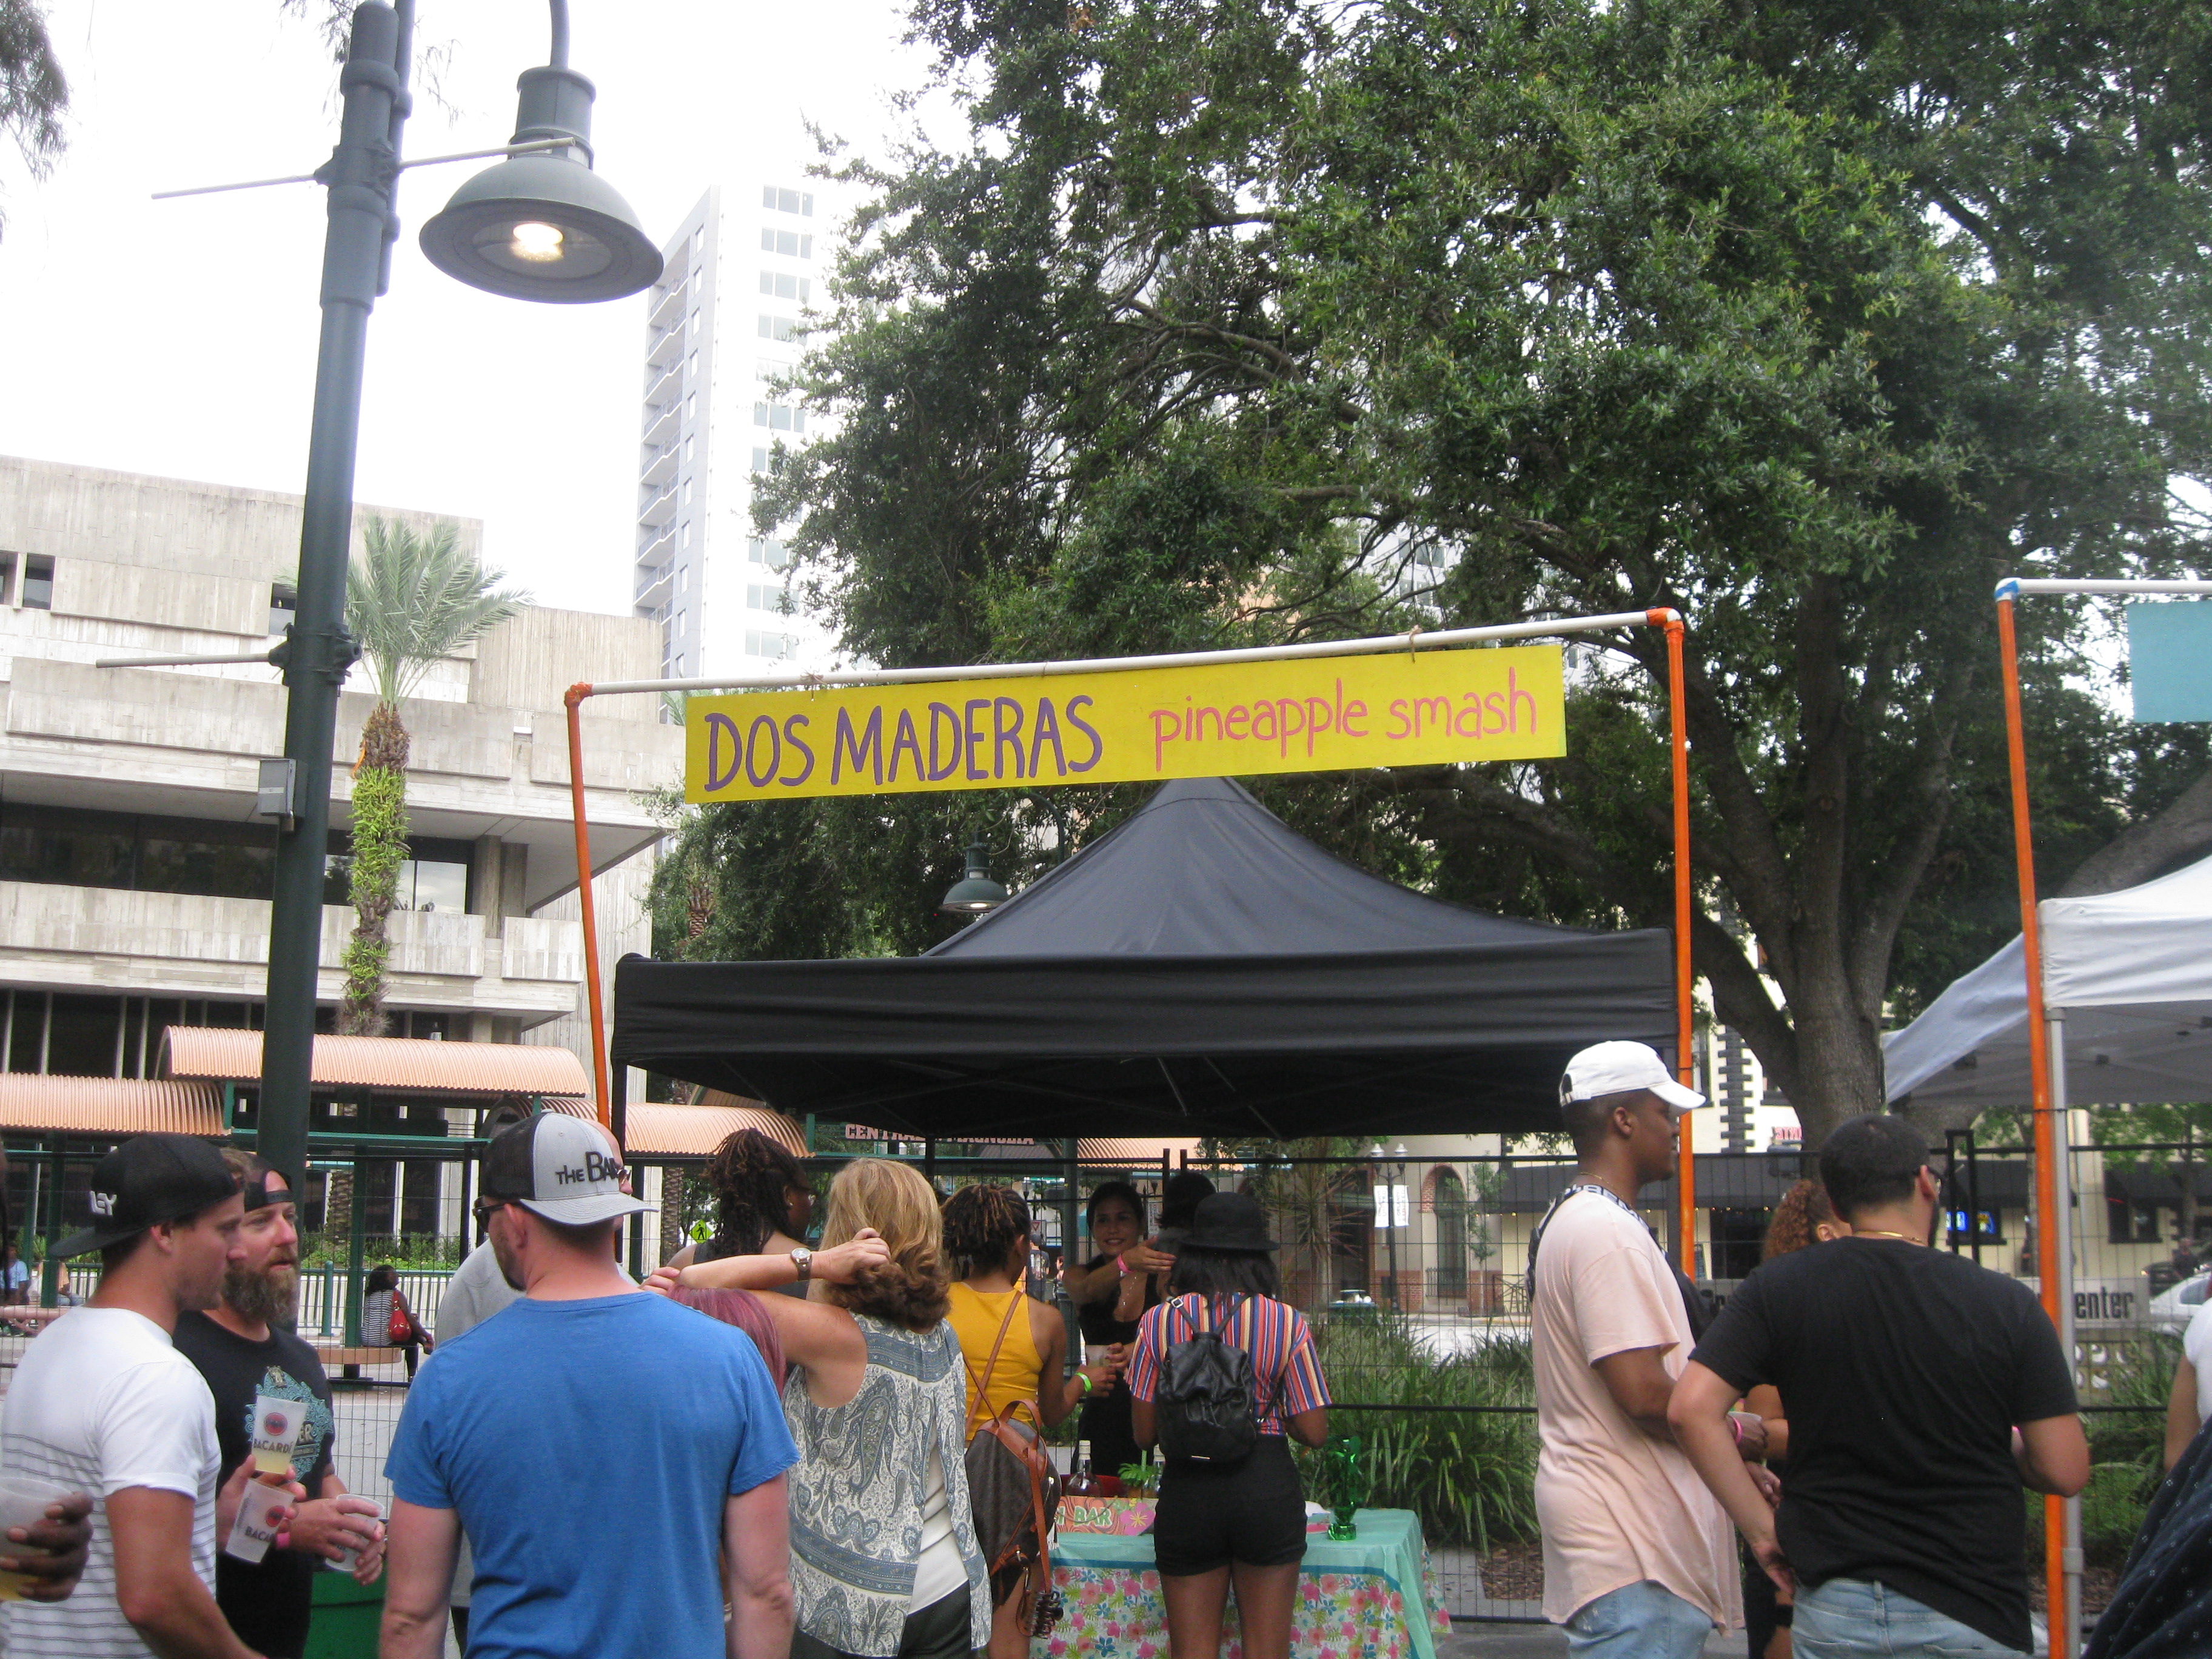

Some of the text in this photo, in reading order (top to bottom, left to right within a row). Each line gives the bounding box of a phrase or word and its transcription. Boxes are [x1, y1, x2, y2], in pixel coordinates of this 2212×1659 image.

[704, 666, 1537, 792] DOS MADERAS pineapple smash
[555, 1165, 585, 1184] THE
[2074, 1285, 2134, 1318] enter
[1073, 1506, 1113, 1526] BAR
